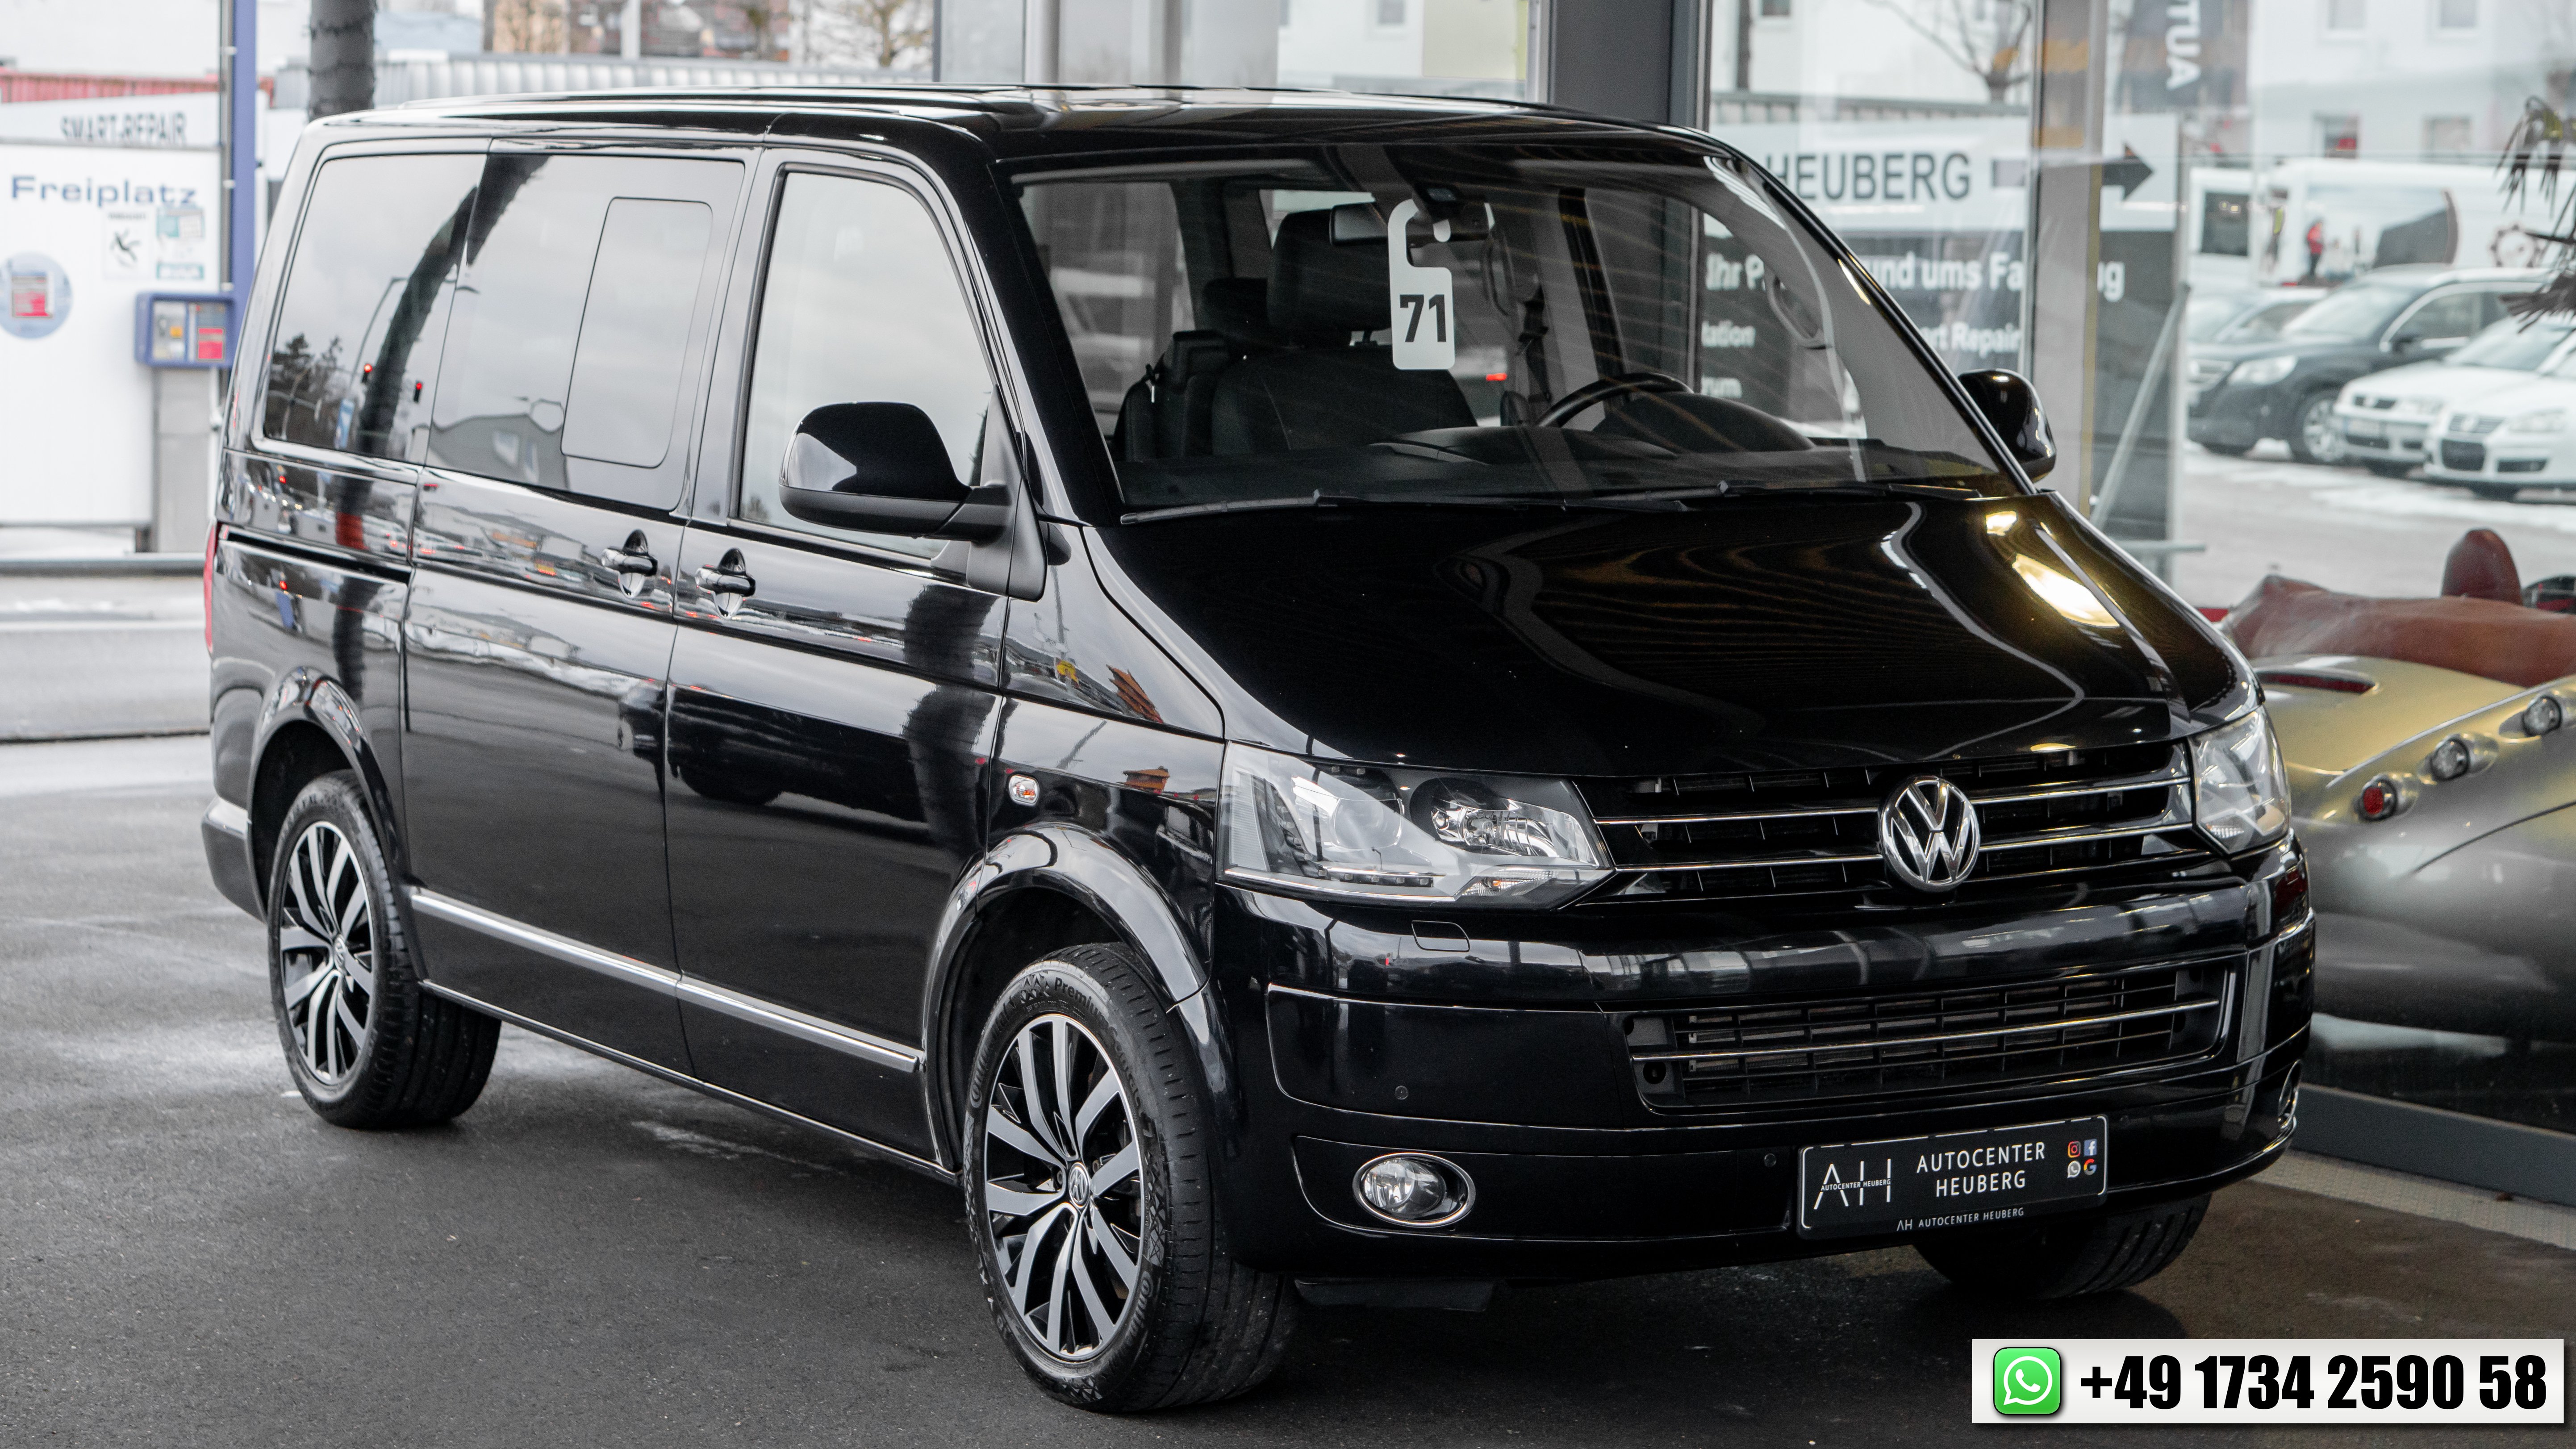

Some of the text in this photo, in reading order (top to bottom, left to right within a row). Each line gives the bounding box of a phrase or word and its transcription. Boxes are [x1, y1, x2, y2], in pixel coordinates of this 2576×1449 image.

[11, 174, 197, 208] Freiplatz
[1765, 151, 1971, 201] HEUBERG
[1921, 259, 1983, 290] ums
[1399, 294, 1447, 342] 71
[1916, 1141, 2045, 1173] AUTOCENTER
[1820, 1179, 1891, 1191] AUTOCENTER HEUBERG
[1936, 1170, 2026, 1198] HEUBERG
[1918, 1212, 1979, 1228] AUTOCENTER
[1983, 1207, 2025, 1221] HEUBERG
